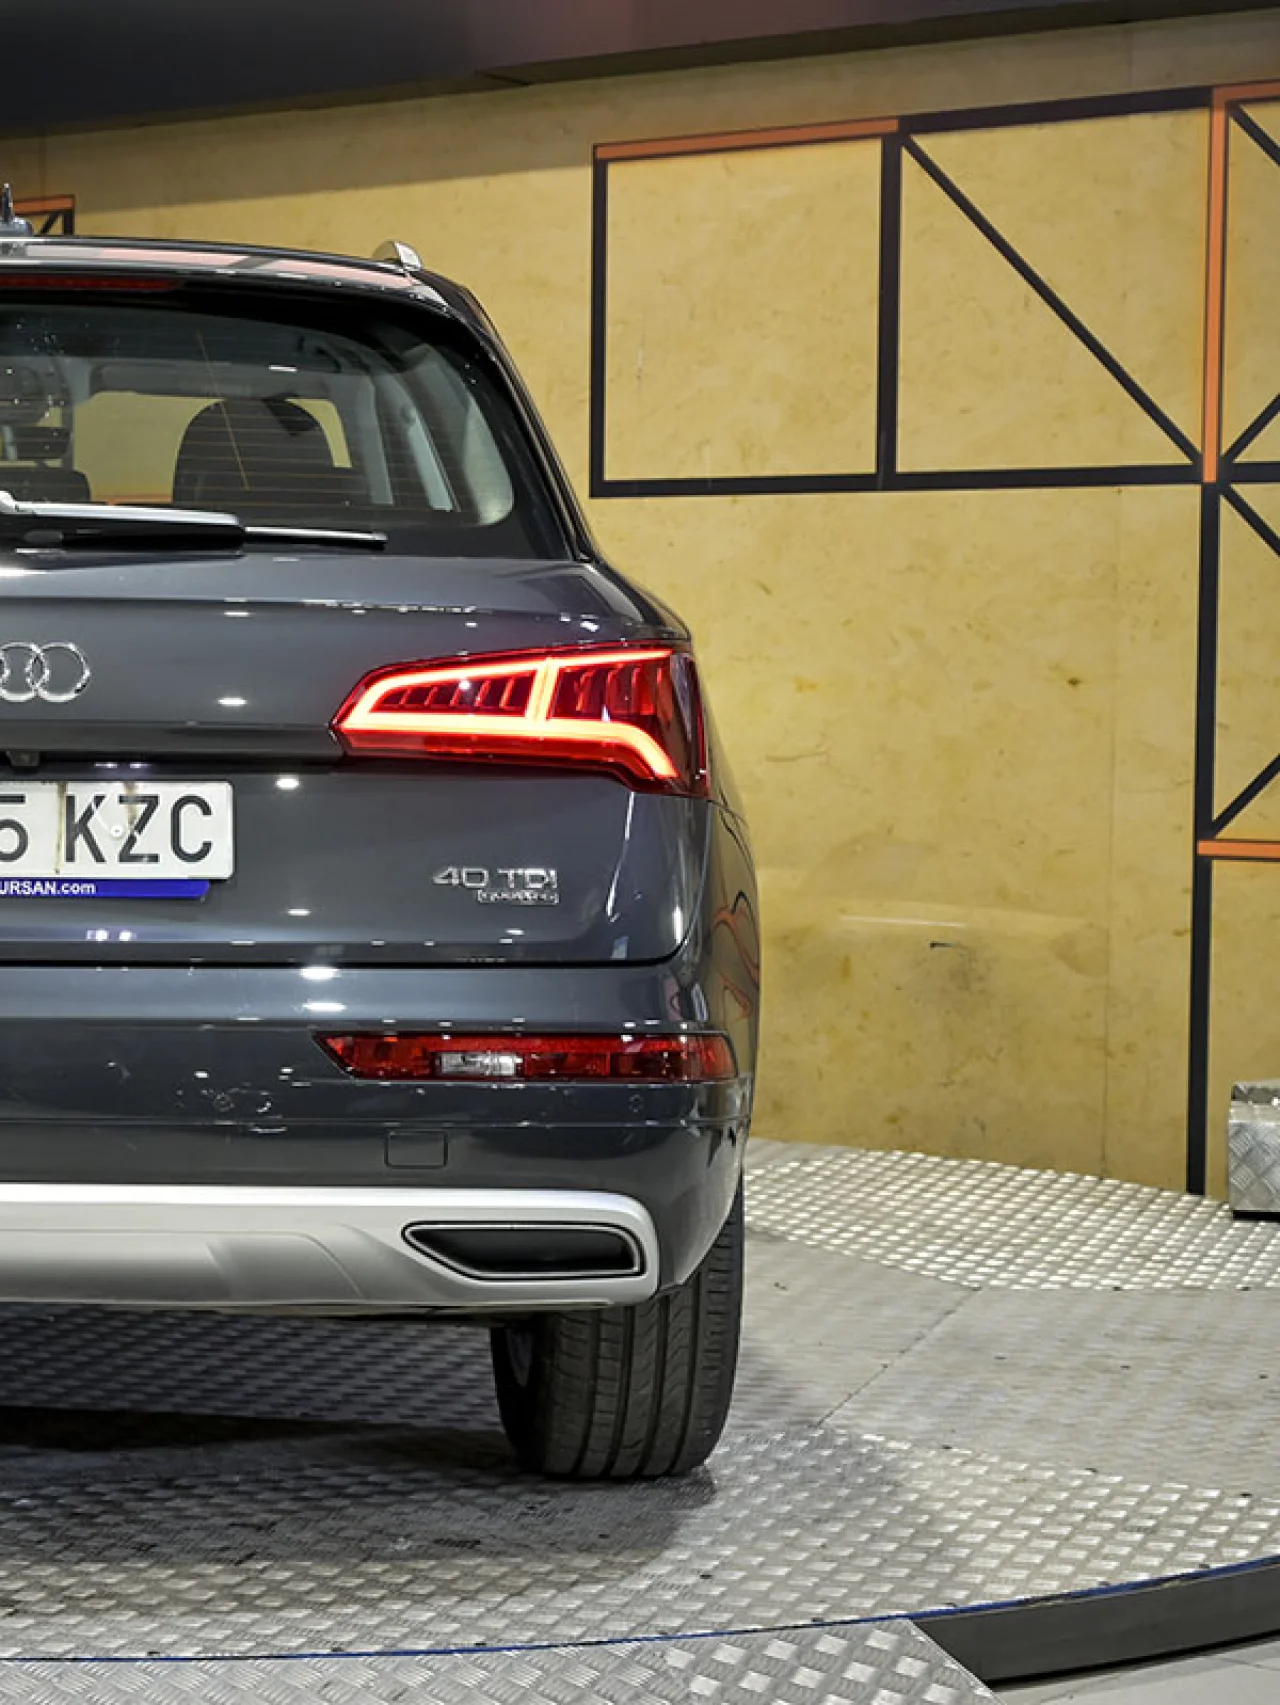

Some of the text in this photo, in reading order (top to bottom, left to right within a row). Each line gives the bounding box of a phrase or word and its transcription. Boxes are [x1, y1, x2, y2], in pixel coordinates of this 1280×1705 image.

[64, 793, 213, 863] KZC
[432, 866, 558, 889] 40 TDI
